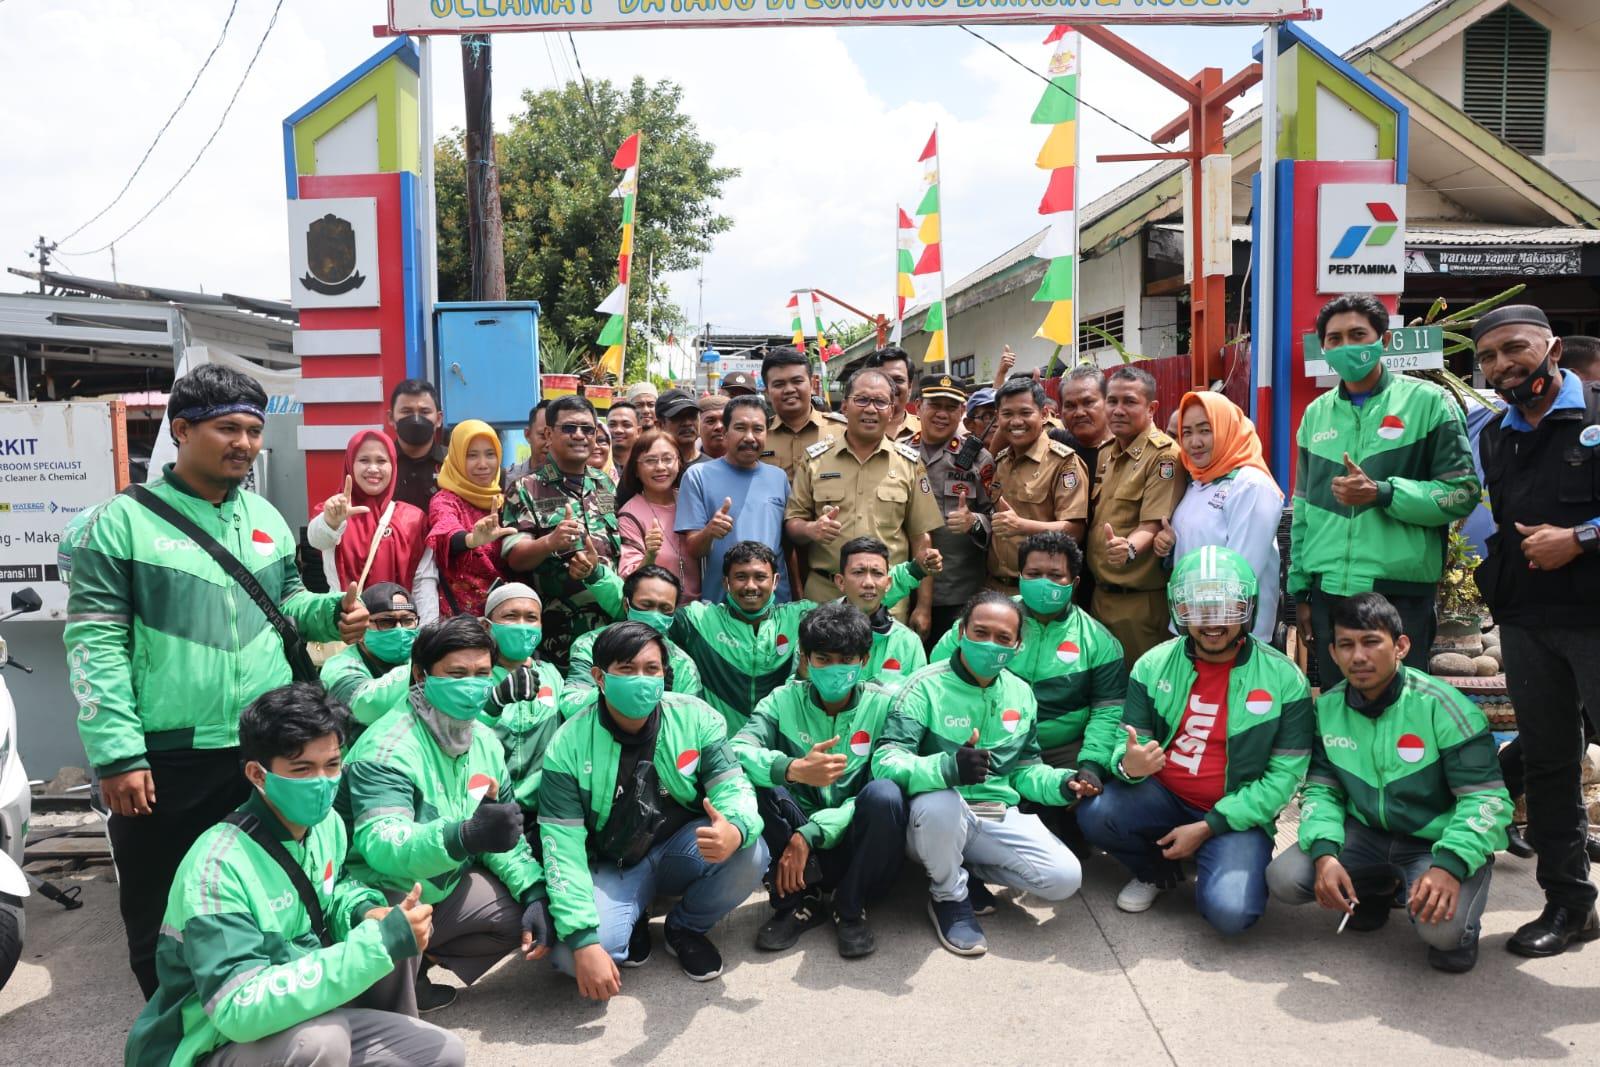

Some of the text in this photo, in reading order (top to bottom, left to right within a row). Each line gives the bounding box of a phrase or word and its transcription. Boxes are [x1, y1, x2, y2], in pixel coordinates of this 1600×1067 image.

[1328, 263, 1397, 275] PERTAMINA
[1386, 356, 1419, 368] 90242
[1312, 428, 1338, 443] Grab
[33, 461, 82, 470] SPECIALIST
[4, 474, 37, 483] Cleaner
[48, 472, 87, 481] Chemical
[233, 567, 286, 632] POLO POWER
[1170, 694, 1219, 776] JUST
[1323, 734, 1358, 751] Grab
[233, 955, 323, 1007] Grab
